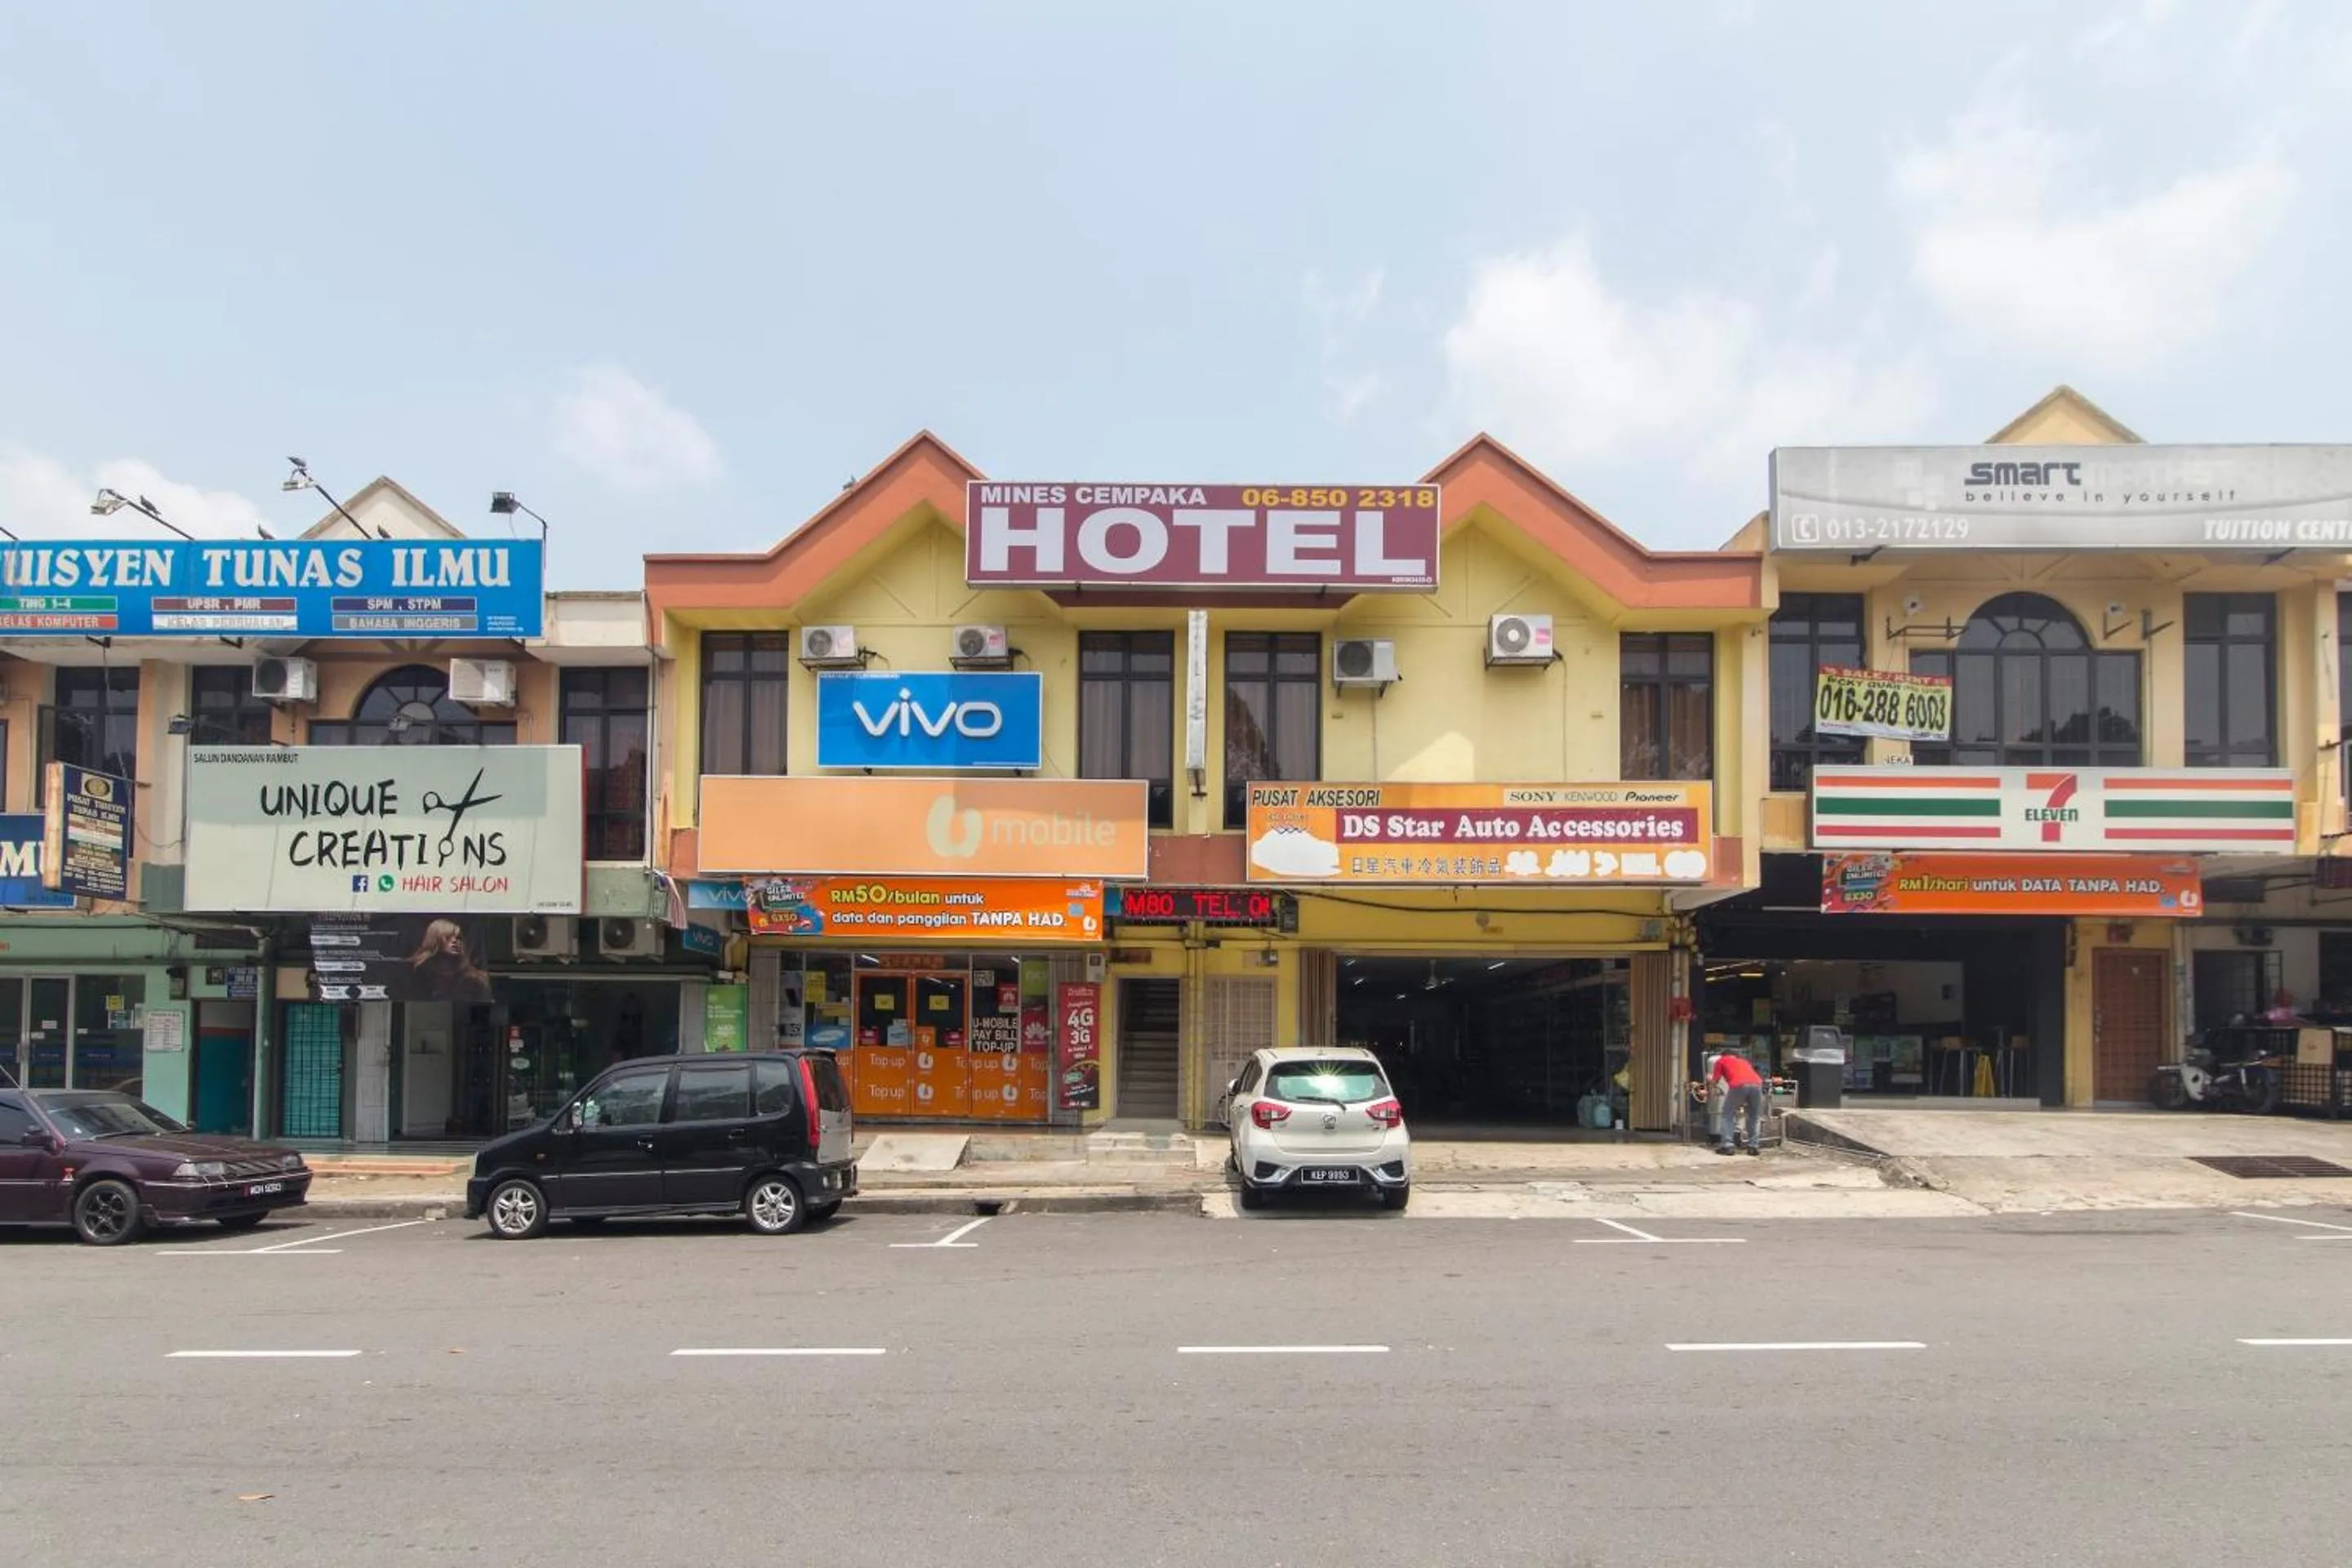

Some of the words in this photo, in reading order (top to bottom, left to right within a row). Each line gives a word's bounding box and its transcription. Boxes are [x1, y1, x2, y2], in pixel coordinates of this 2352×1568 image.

[1965, 461, 2082, 486] smart
[981, 487, 1067, 505] MINES
[1075, 487, 1207, 506] CEMPAKA
[1242, 488, 1348, 507] 06-850
[1358, 490, 1435, 508] 2318
[1965, 490, 2065, 502] believe
[2083, 491, 2104, 502] in
[2123, 490, 2236, 504] yourself
[1826, 517, 1969, 539] 013-2172129
[2205, 519, 2291, 541] TUITION
[980, 506, 1427, 577] HOTEL
[0, 548, 175, 587] UISYEN
[203, 548, 364, 588] TUNAS
[391, 548, 511, 587] ILMU
[187, 598, 220, 610] UPSR
[234, 599, 261, 610] PMR
[367, 598, 393, 610] SPM
[408, 599, 442, 611] STPM
[37, 615, 99, 628] KOMPUTER
[349, 617, 399, 630] BAHASA
[403, 617, 461, 630] INGGERIS
[853, 687, 1003, 737] vivo
[1820, 684, 1900, 727] 016-288
[1905, 693, 1946, 732] 6003
[261, 779, 399, 819] UNIQUE
[1252, 789, 1299, 807] PUSAT
[1306, 789, 1381, 807] AKSESORI
[1509, 791, 1557, 802] SONY
[1564, 791, 1619, 802] KENWOOD
[1625, 791, 1680, 802] Pioneer
[992, 808, 1117, 846] mobile
[1343, 814, 1381, 838] DS
[1387, 814, 1446, 838] Star
[1454, 814, 1520, 838] Auto
[1526, 814, 1684, 838] Accessories
[402, 875, 443, 892] HAIR
[450, 875, 508, 893] SALON
[1898, 874, 1969, 891] RM1/hari
[1971, 878, 2017, 892] untuk
[2021, 879, 2063, 892] DATA
[2068, 879, 2120, 892] TANPA
[2125, 880, 2166, 893] HAD.
[831, 884, 940, 905] RM50/bulan
[945, 892, 984, 905] untuk
[832, 911, 863, 924] data
[867, 911, 893, 925] dan
[898, 912, 967, 929] panggilan
[970, 912, 1023, 926] TANPA
[1027, 912, 1067, 927] HAD.
[1067, 1008, 1095, 1027] 4G
[973, 1029, 992, 1040] PAY
[995, 1029, 1017, 1040] BILL
[1070, 1029, 1091, 1045] 3G
[975, 1040, 1015, 1054] TOP-UP
